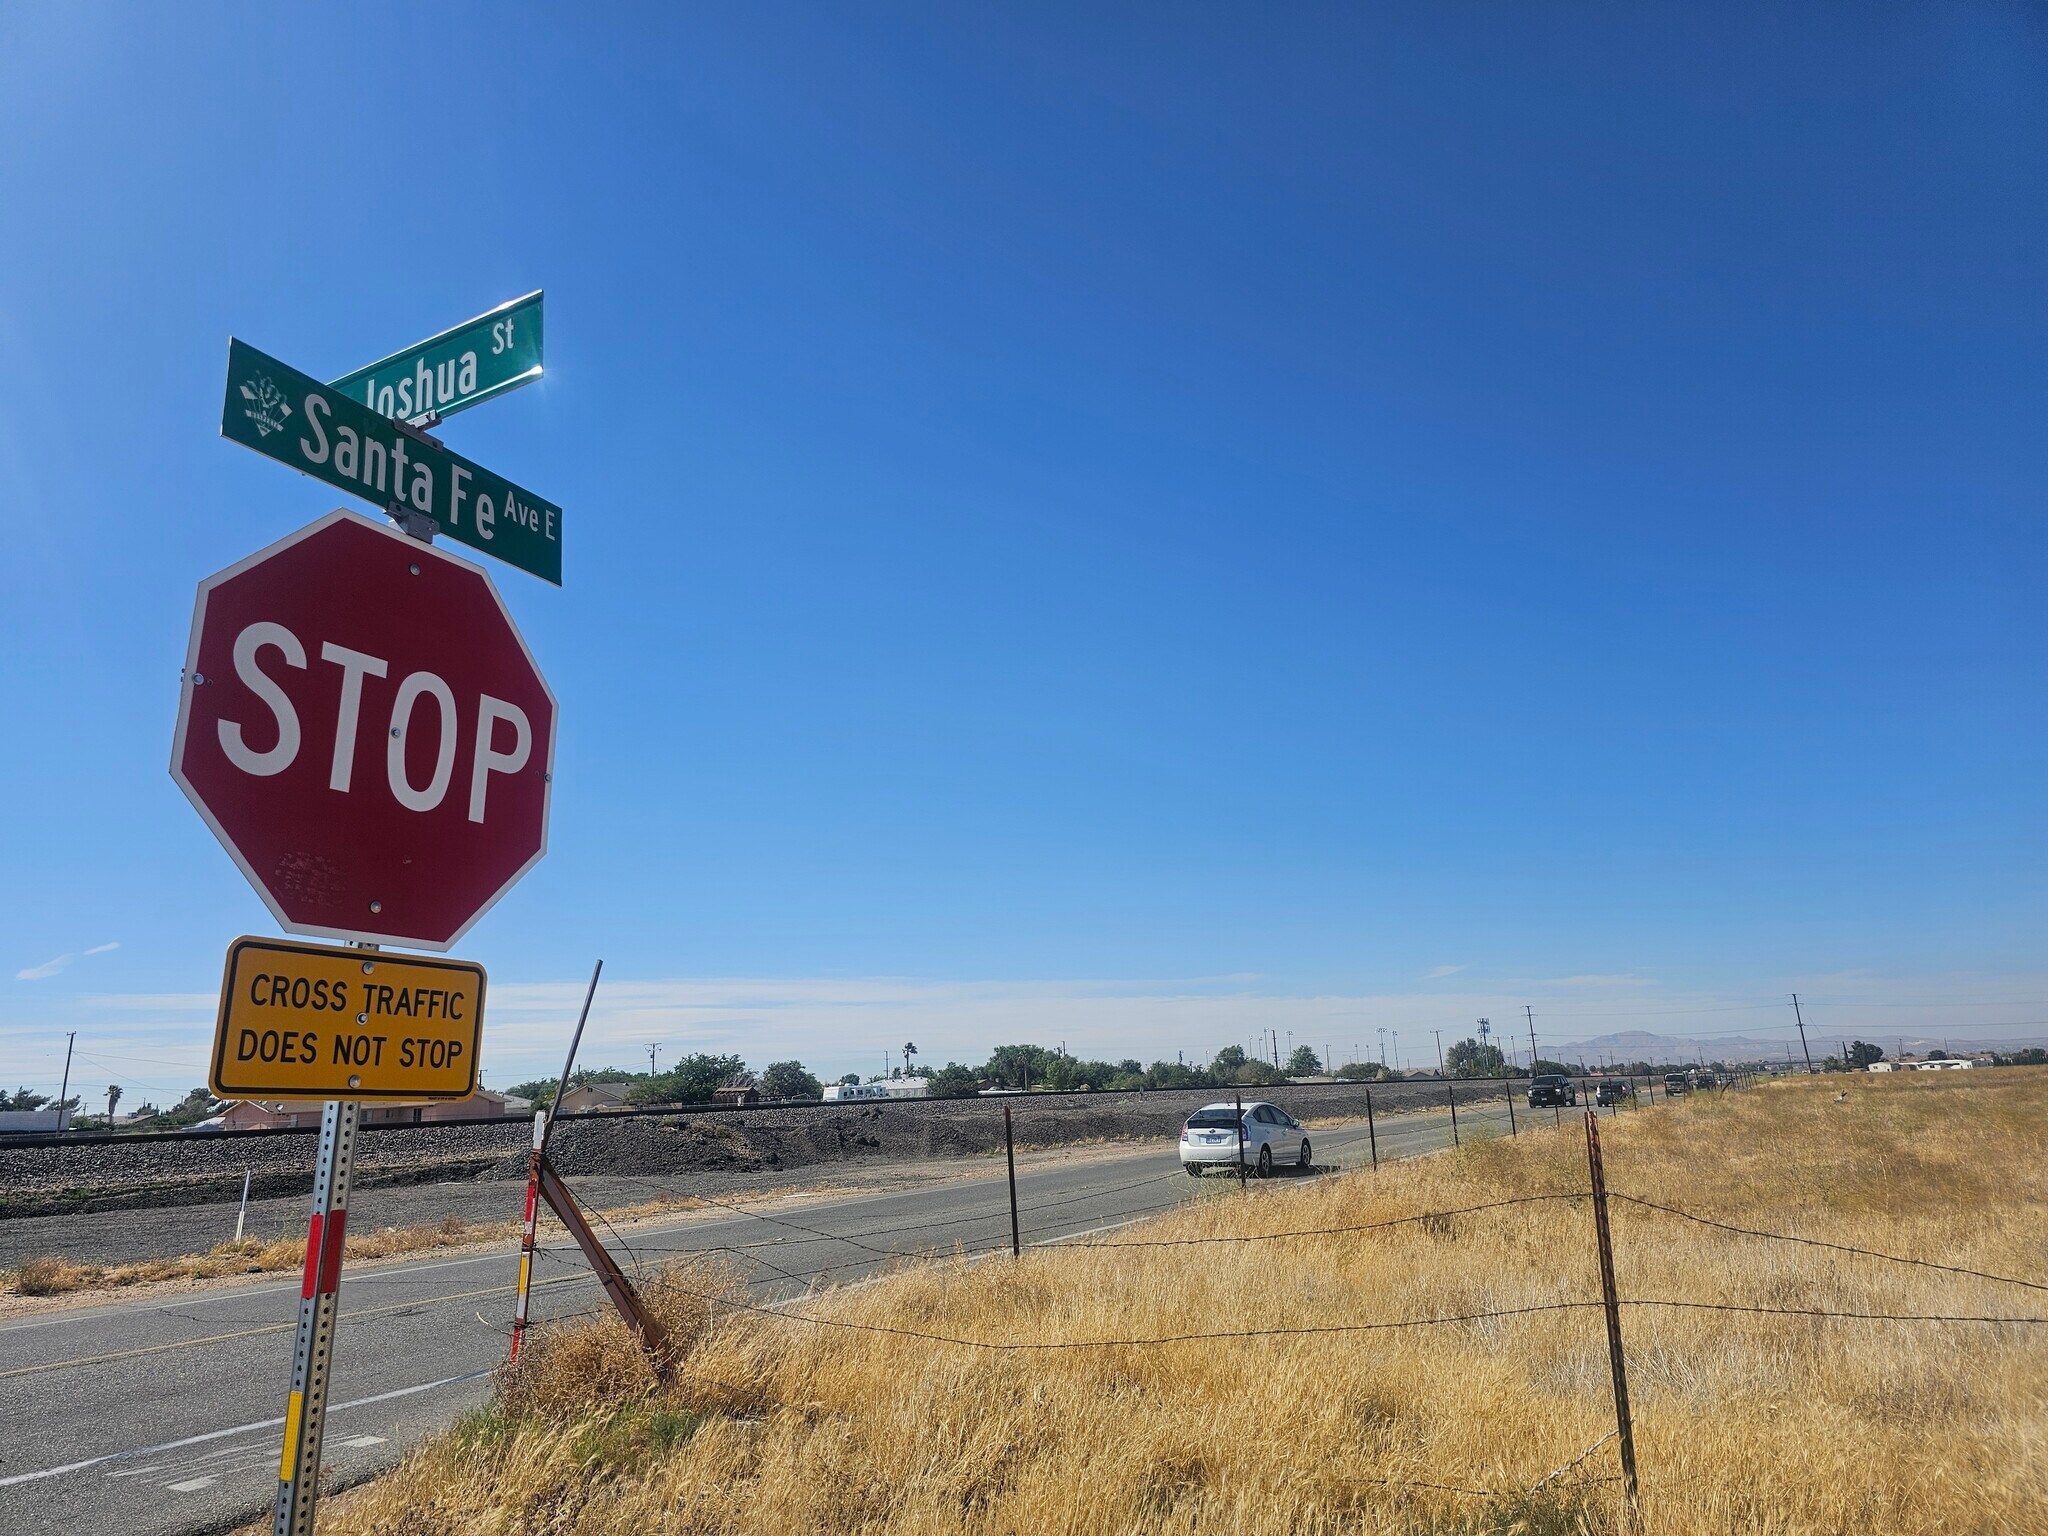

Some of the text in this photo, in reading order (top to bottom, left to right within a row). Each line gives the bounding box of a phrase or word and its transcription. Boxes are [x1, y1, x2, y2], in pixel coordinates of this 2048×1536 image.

[366, 318, 514, 420] Joshua St
[300, 393, 555, 541] Santa Fe Ave E
[217, 621, 532, 824] STOP
[251, 973, 465, 1020] CROSS TRAFFIC
[237, 1028, 463, 1069] DOES NOT STOP
